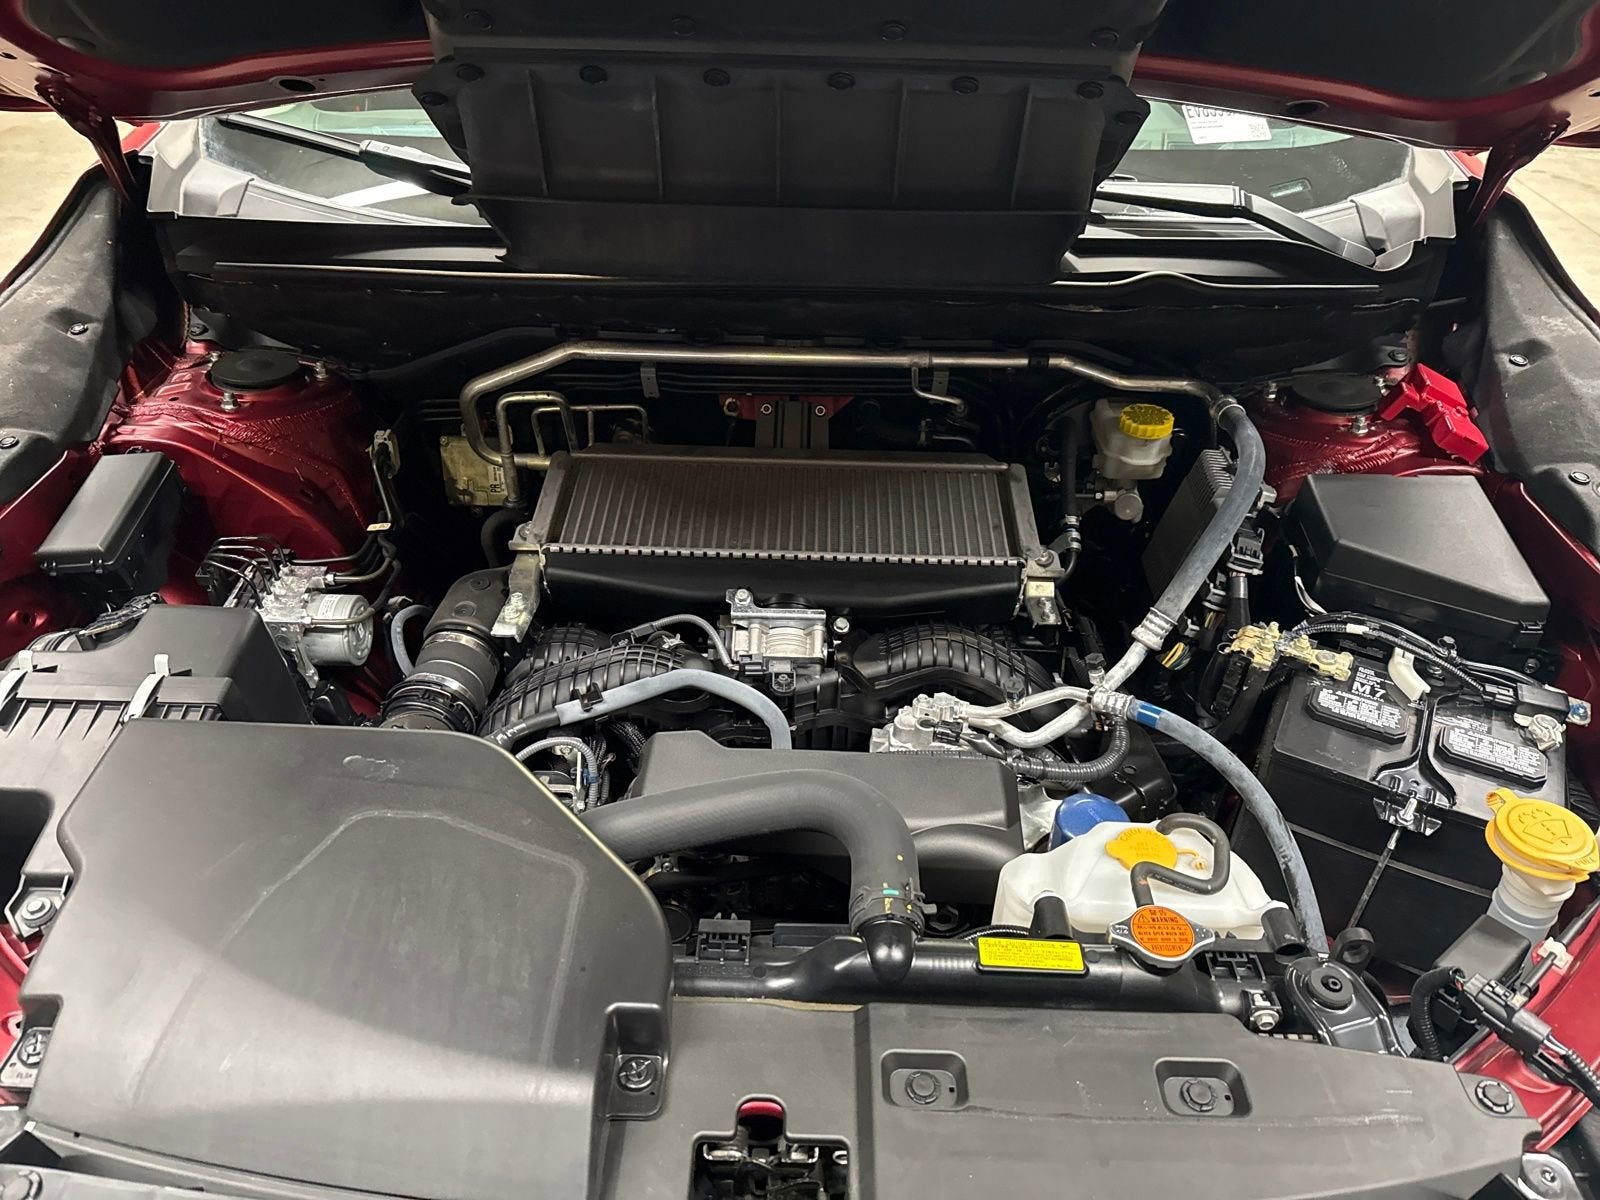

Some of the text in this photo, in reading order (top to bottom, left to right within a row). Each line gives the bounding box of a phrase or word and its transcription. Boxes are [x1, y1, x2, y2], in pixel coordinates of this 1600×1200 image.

[489, 483, 502, 493] PR
[1351, 682, 1372, 695] M
[1373, 687, 1387, 698] 7
